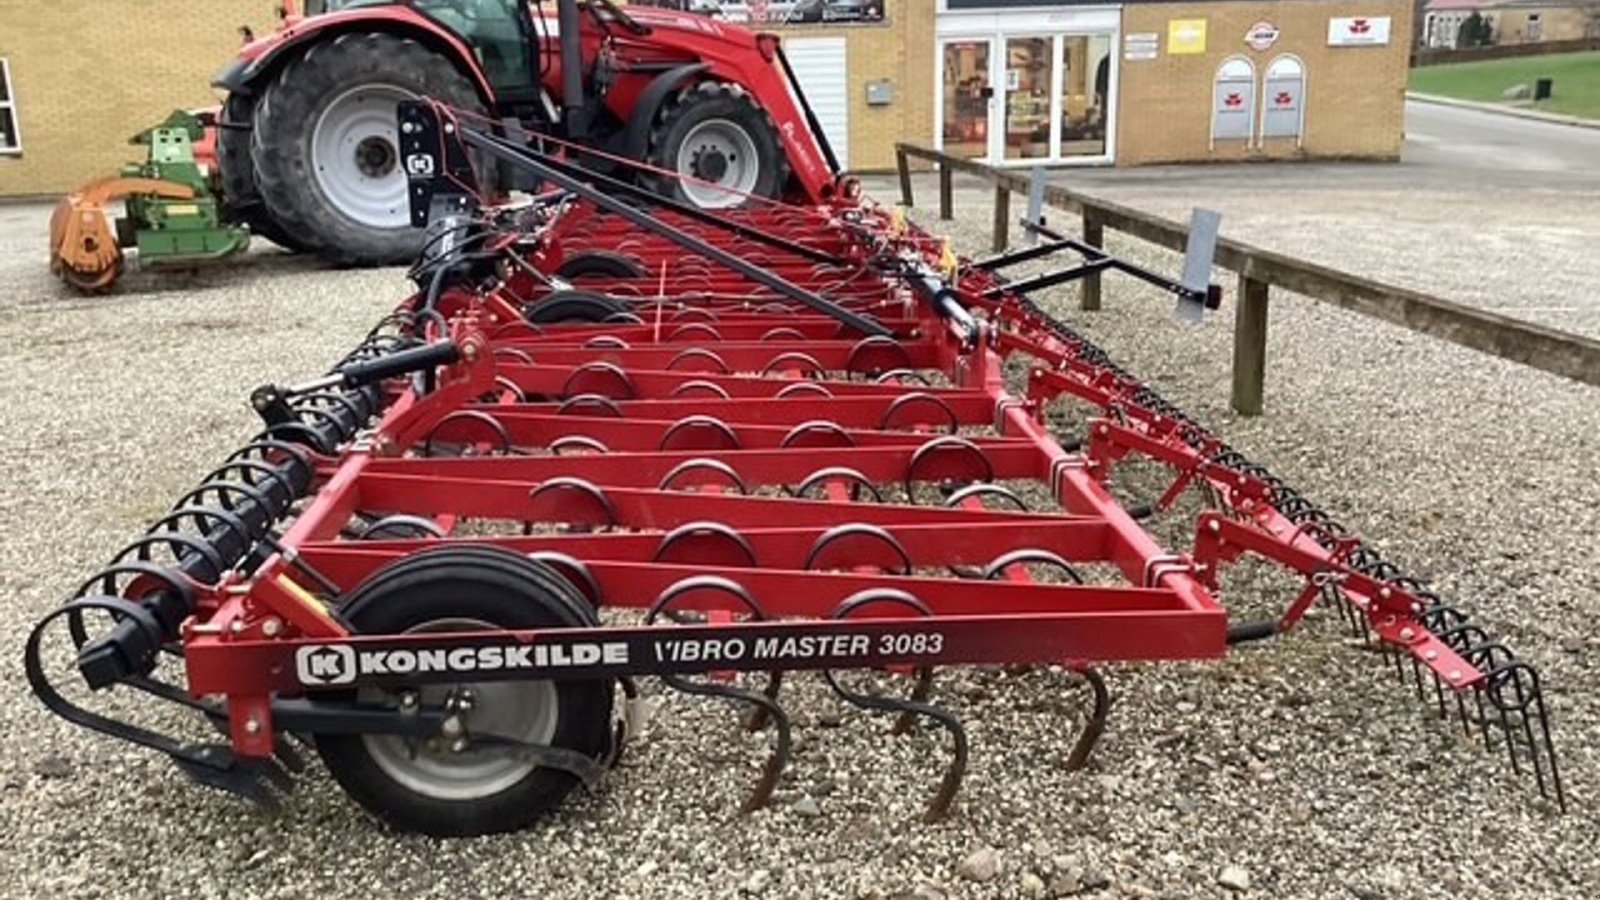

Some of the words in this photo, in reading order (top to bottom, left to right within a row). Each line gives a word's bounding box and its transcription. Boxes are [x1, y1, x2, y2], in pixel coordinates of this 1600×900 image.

[359, 643, 629, 673] KONGSKILDE
[655, 638, 745, 662] VIBRO
[753, 635, 870, 659] MASTER
[878, 633, 945, 655] 3083
